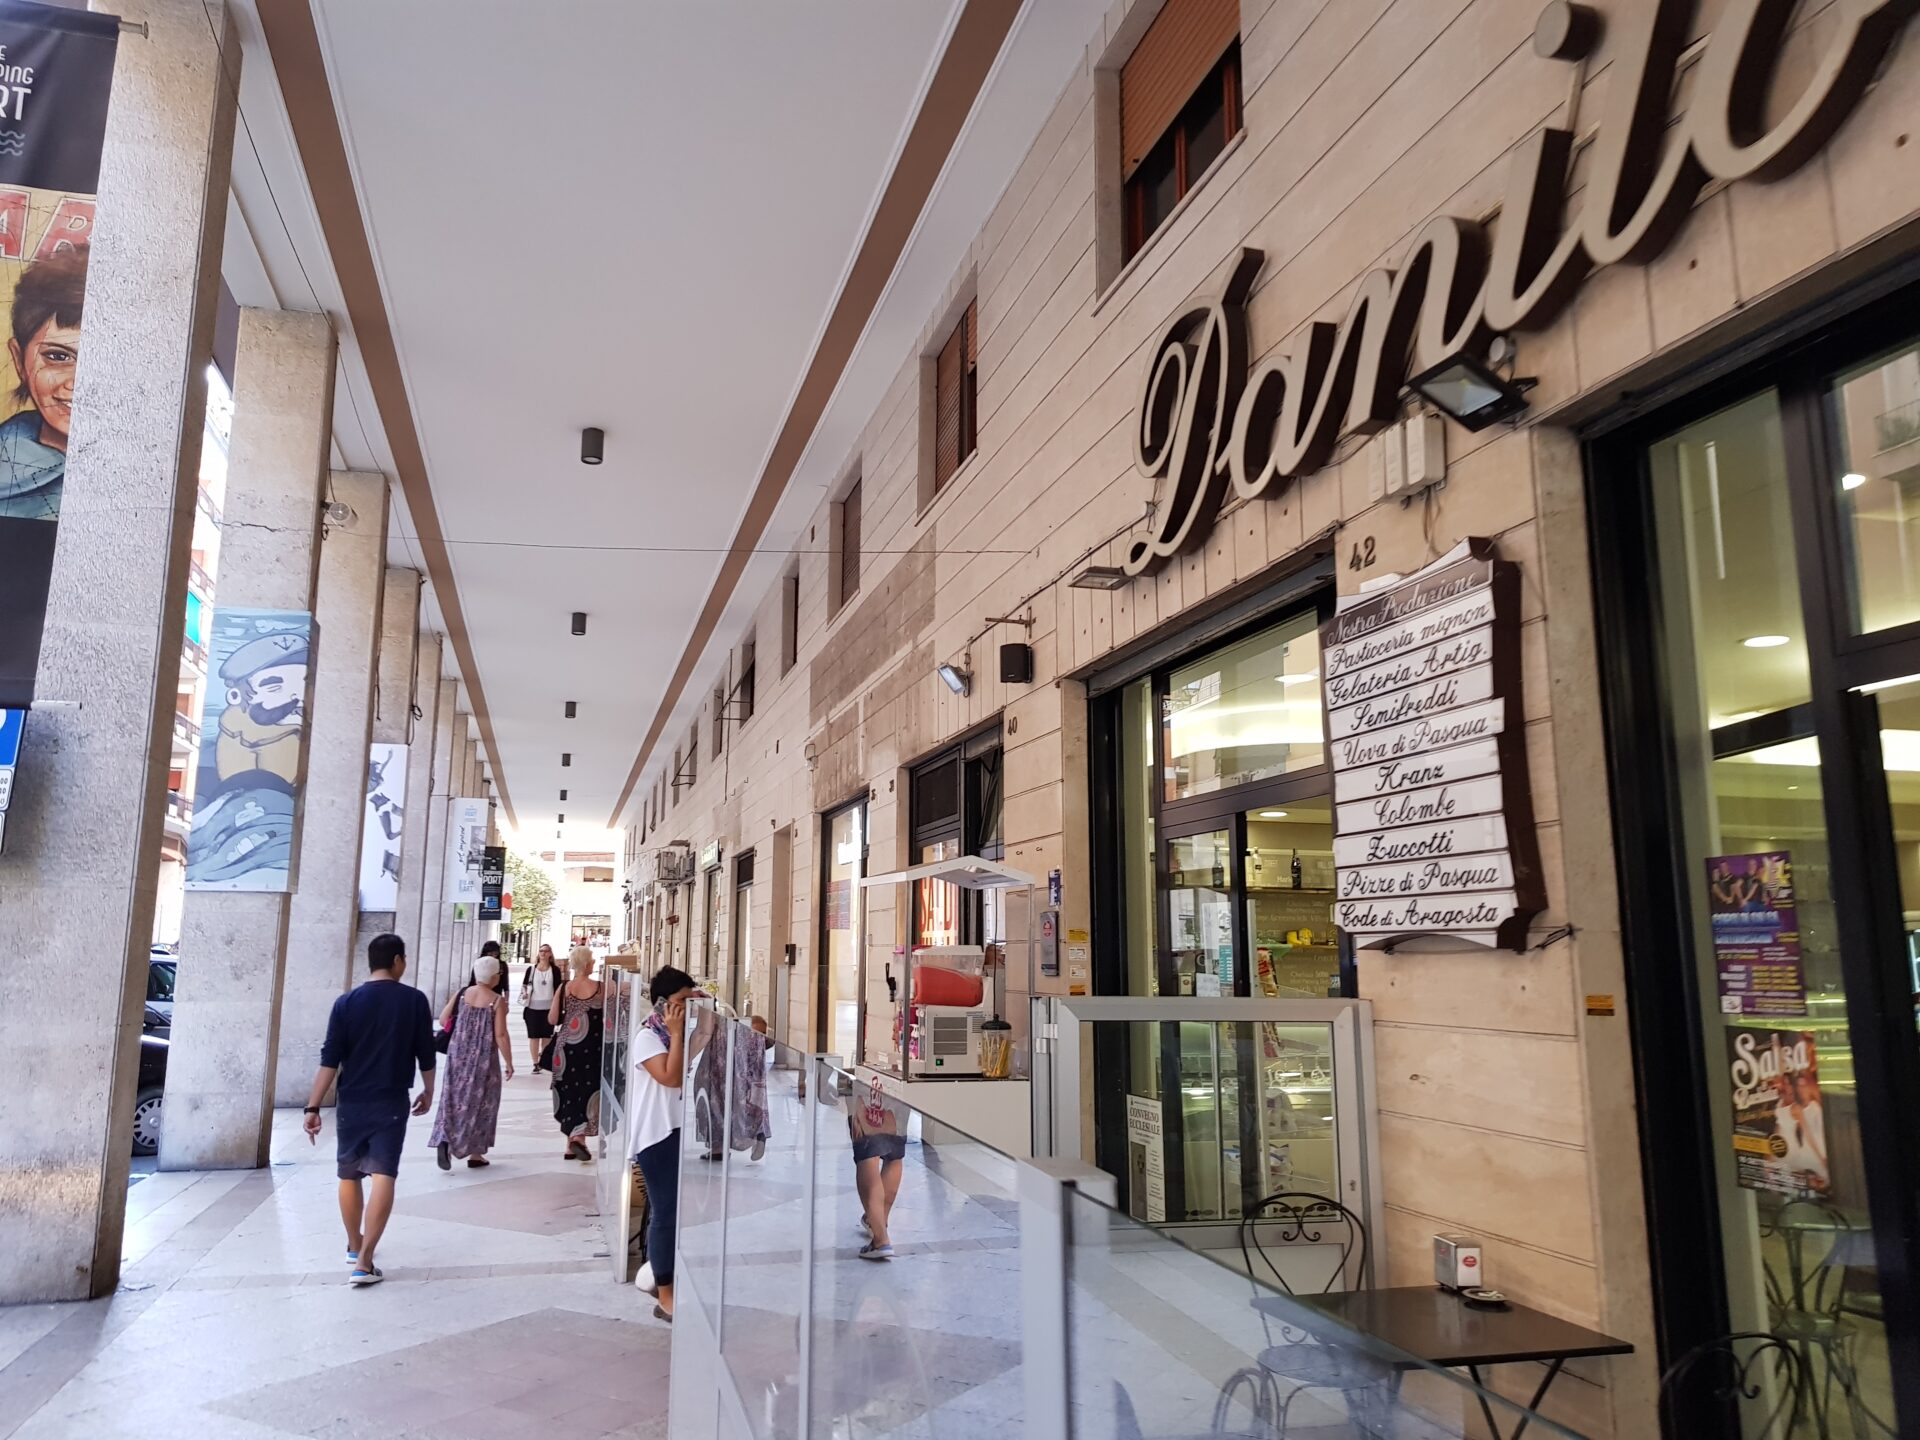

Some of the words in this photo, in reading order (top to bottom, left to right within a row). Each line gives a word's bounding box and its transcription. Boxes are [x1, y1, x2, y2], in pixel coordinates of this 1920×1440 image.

[1349, 536, 1376, 572] 42
[1328, 614, 1378, 646] Nostra
[1376, 573, 1480, 624] Produzione
[1329, 630, 1414, 676] Pasticceria
[1420, 602, 1491, 645] mignon
[1330, 663, 1412, 705] Gelateria
[1414, 640, 1487, 678] Artig.
[1350, 680, 1458, 729] Semifreddi
[1007, 716, 1018, 736] 40
[1343, 738, 1388, 765] Uova
[1391, 733, 1406, 754] di
[1408, 716, 1488, 750] Pasqua
[1374, 762, 1444, 791] Kranz
[1374, 787, 1456, 826] Colombe
[1366, 830, 1454, 862] Zuccotti
[1343, 870, 1396, 897] Pizze
[1399, 872, 1414, 892] di
[1418, 862, 1499, 891] Pasqua
[1340, 903, 1377, 928] Code
[1380, 910, 1394, 926] di
[1396, 899, 1499, 927] Aragosta
[1731, 1032, 1810, 1090] Salsa
[1128, 1106, 1160, 1123] CONVEGNO
